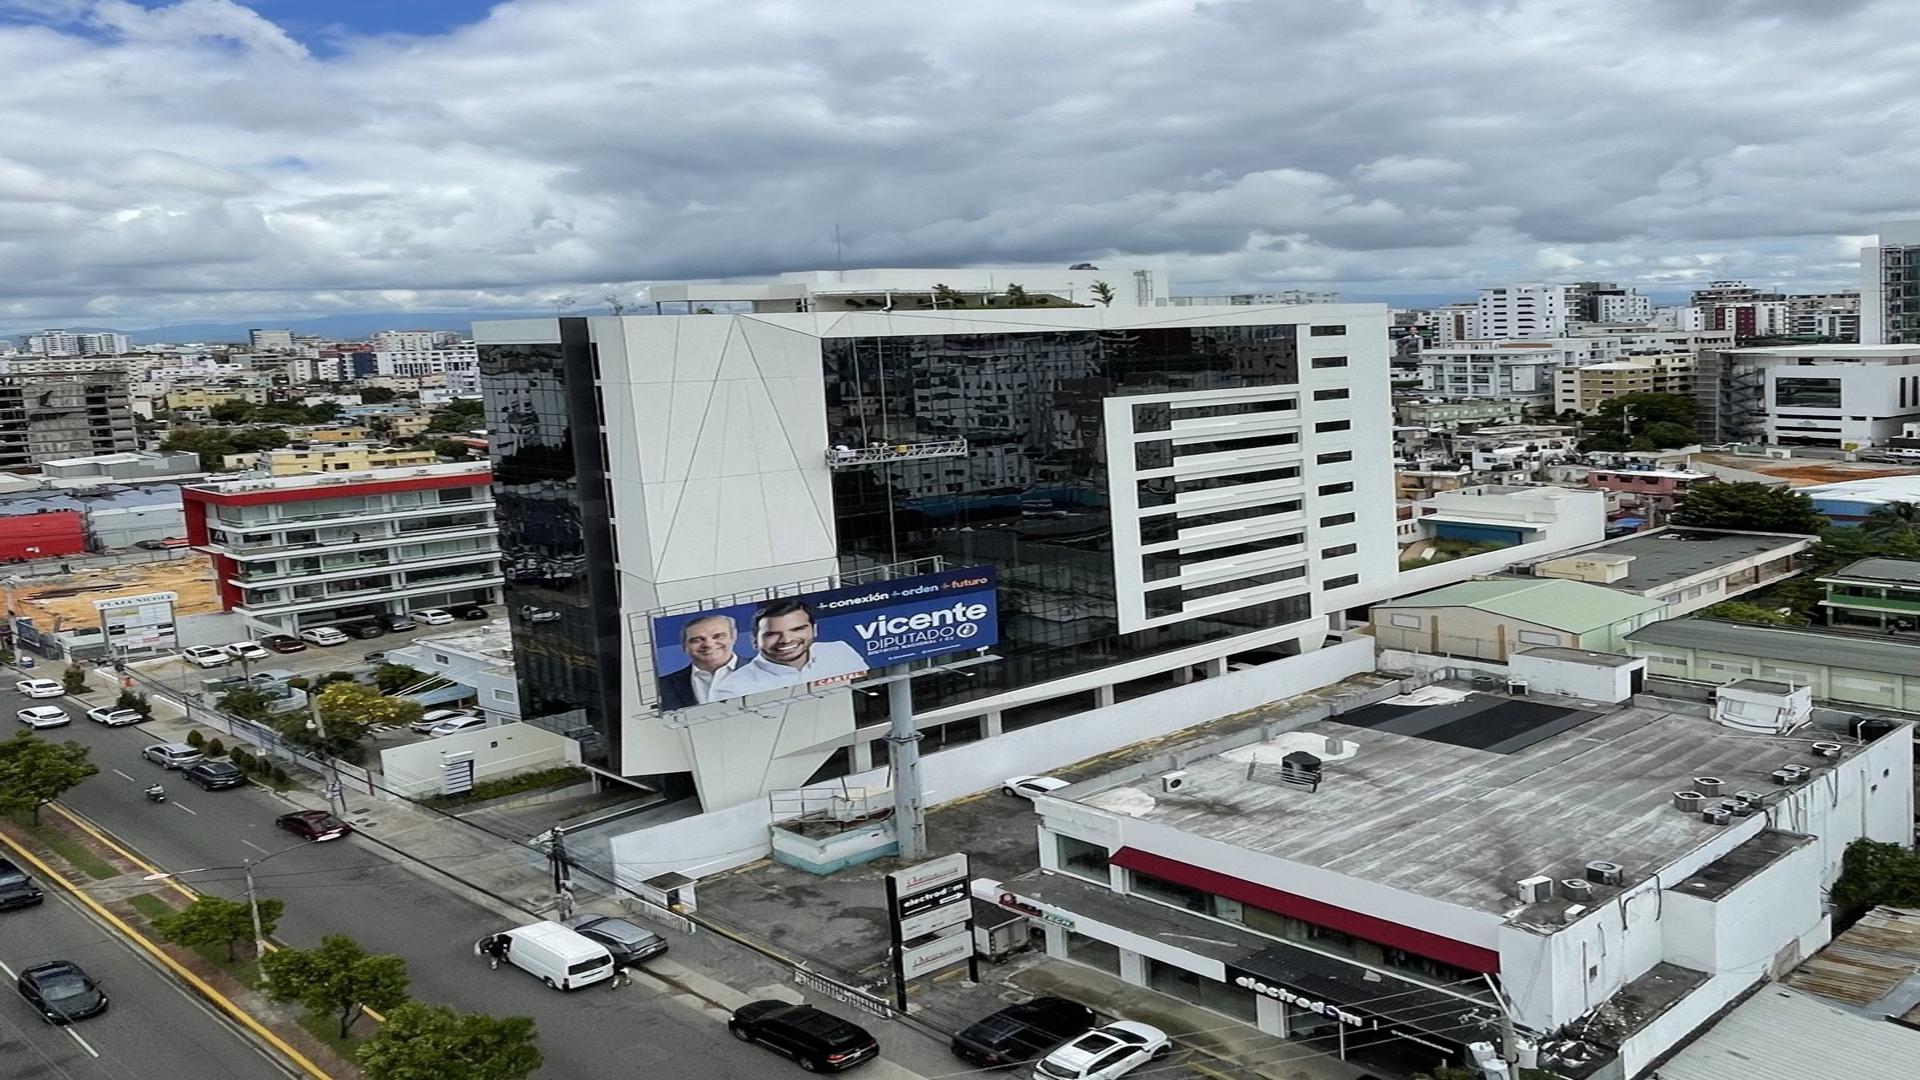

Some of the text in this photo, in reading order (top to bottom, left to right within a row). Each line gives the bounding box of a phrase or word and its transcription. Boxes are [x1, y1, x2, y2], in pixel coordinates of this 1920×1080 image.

[854, 602, 988, 640] vicente
[866, 626, 955, 652] DIPUTADO
[1235, 976, 1363, 1027] electrodom
